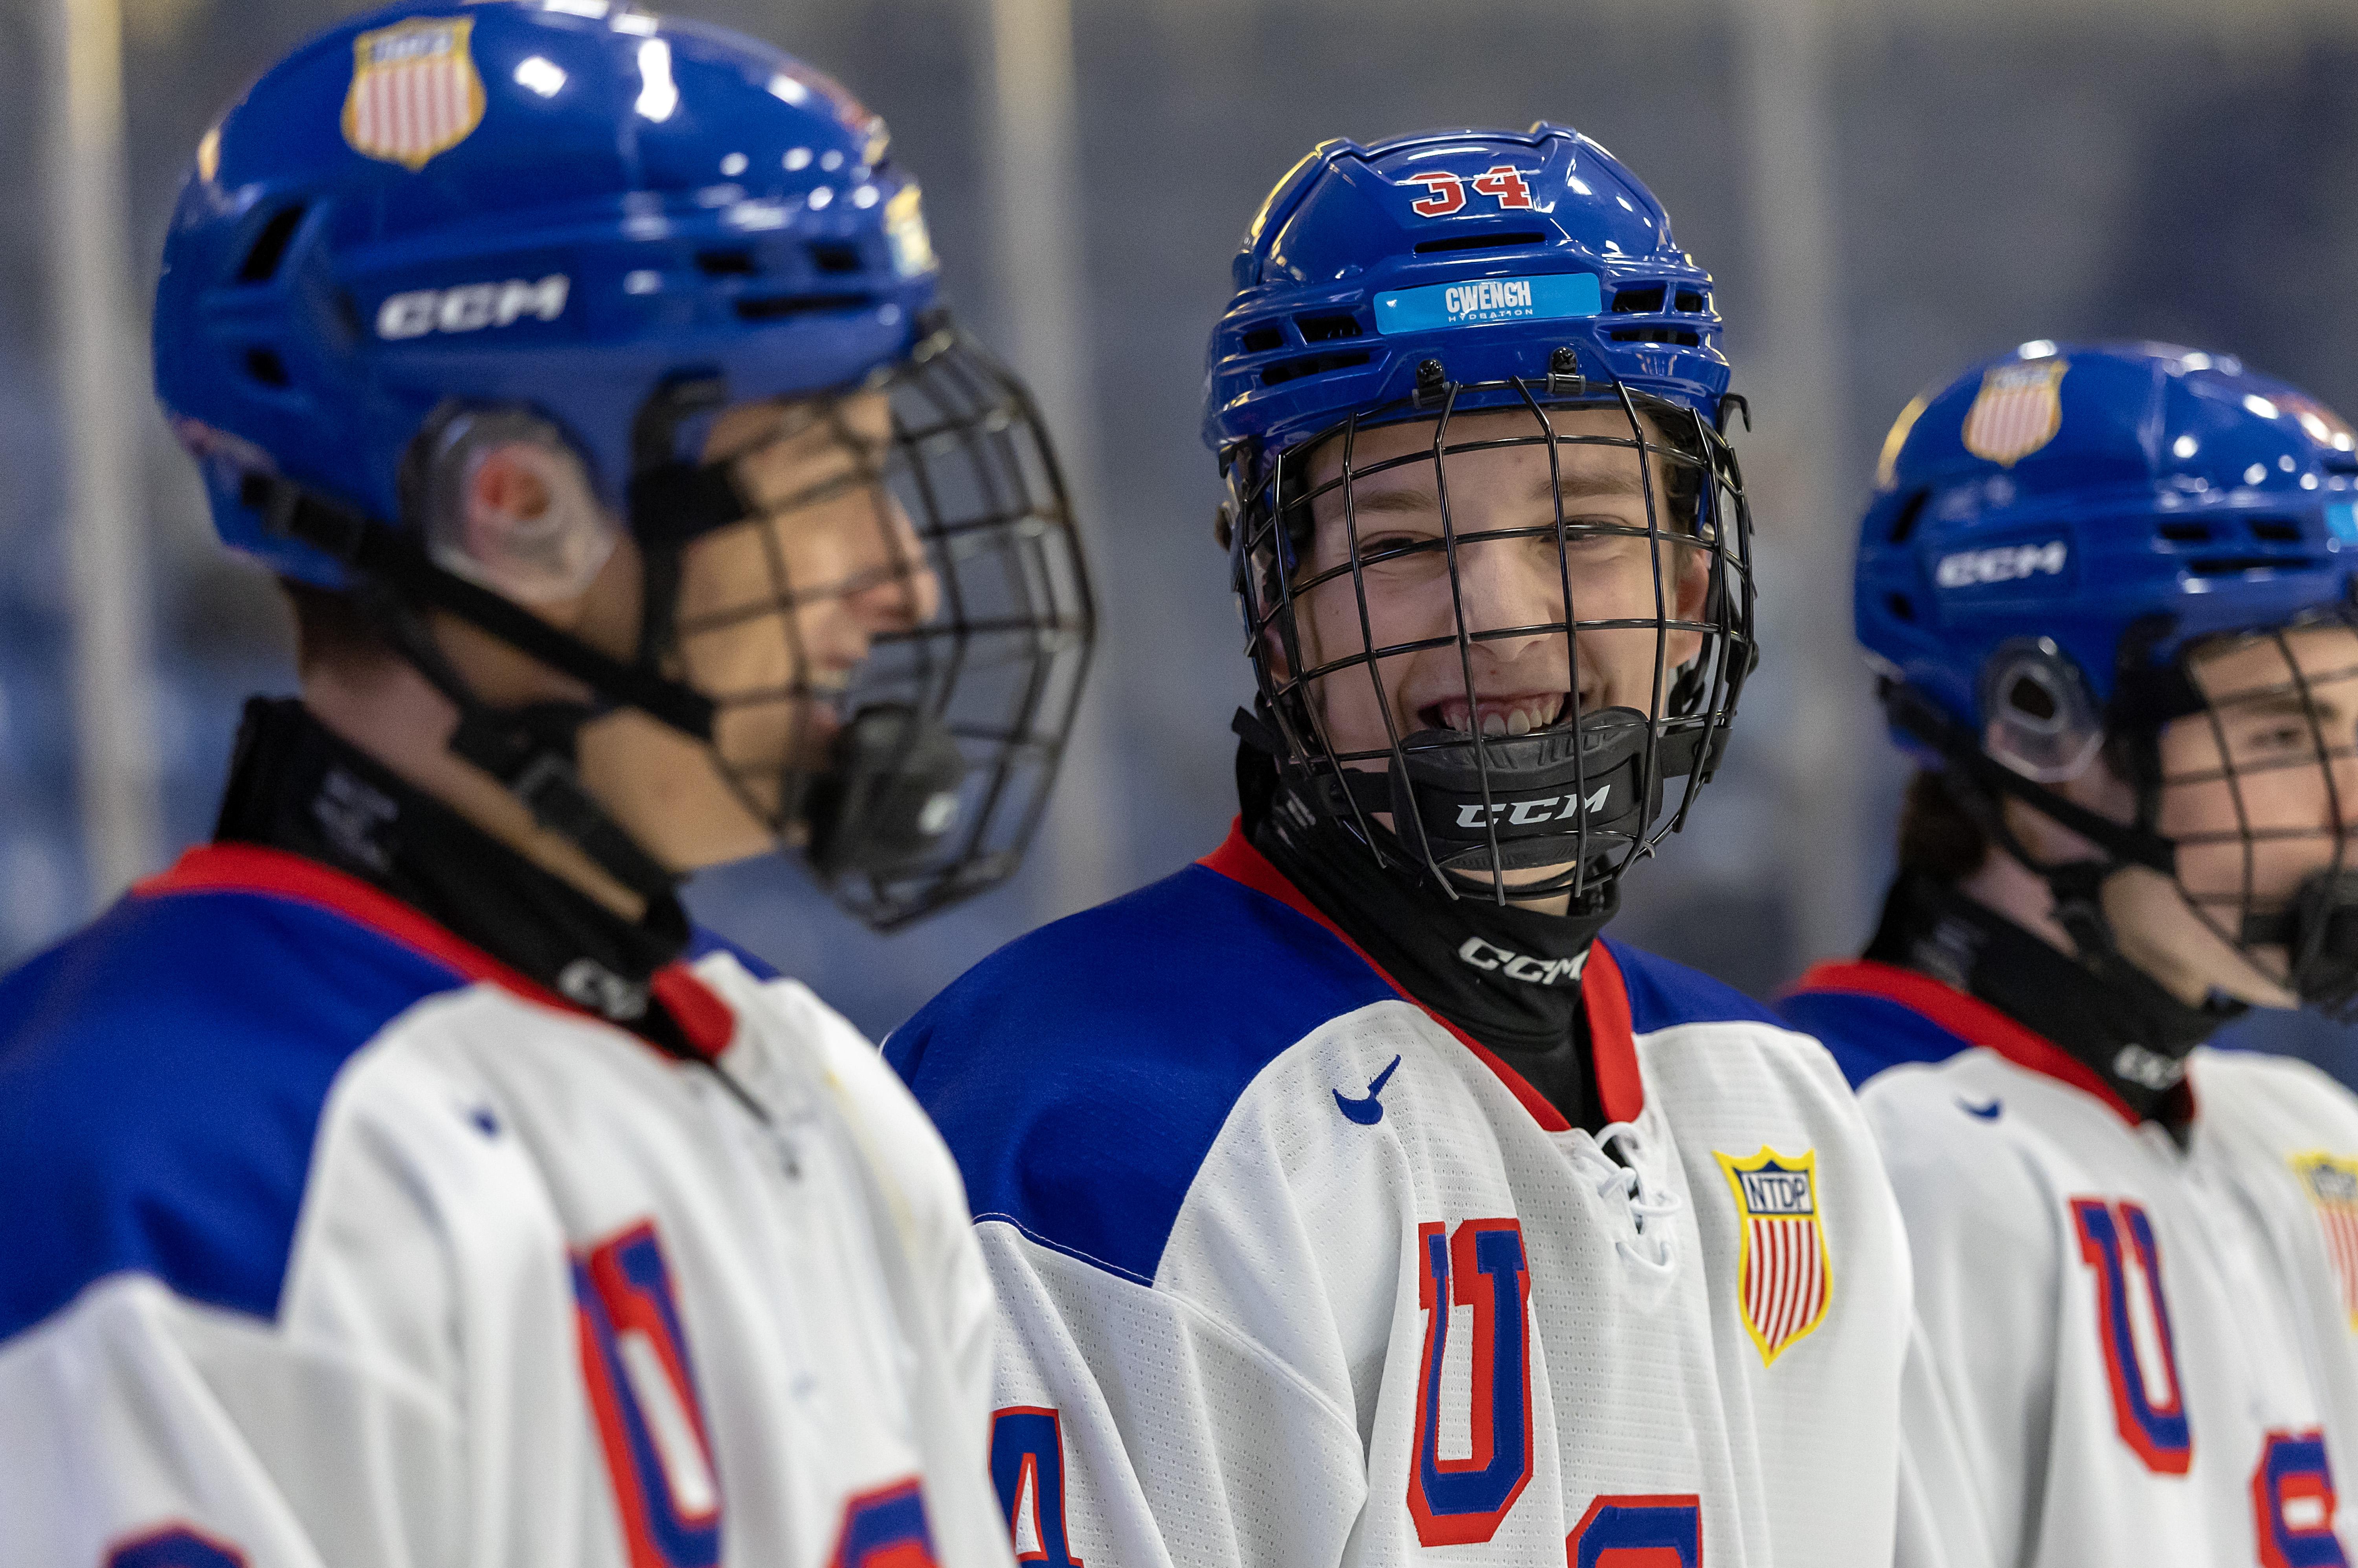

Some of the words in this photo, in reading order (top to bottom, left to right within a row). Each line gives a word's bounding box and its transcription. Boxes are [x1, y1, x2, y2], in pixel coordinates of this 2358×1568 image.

[1409, 165, 1533, 218] 34
[375, 272, 571, 341] CCM
[1456, 784, 1611, 827] CCM
[1458, 936, 1590, 985] CCM
[1748, 1176, 1805, 1211] NTDP
